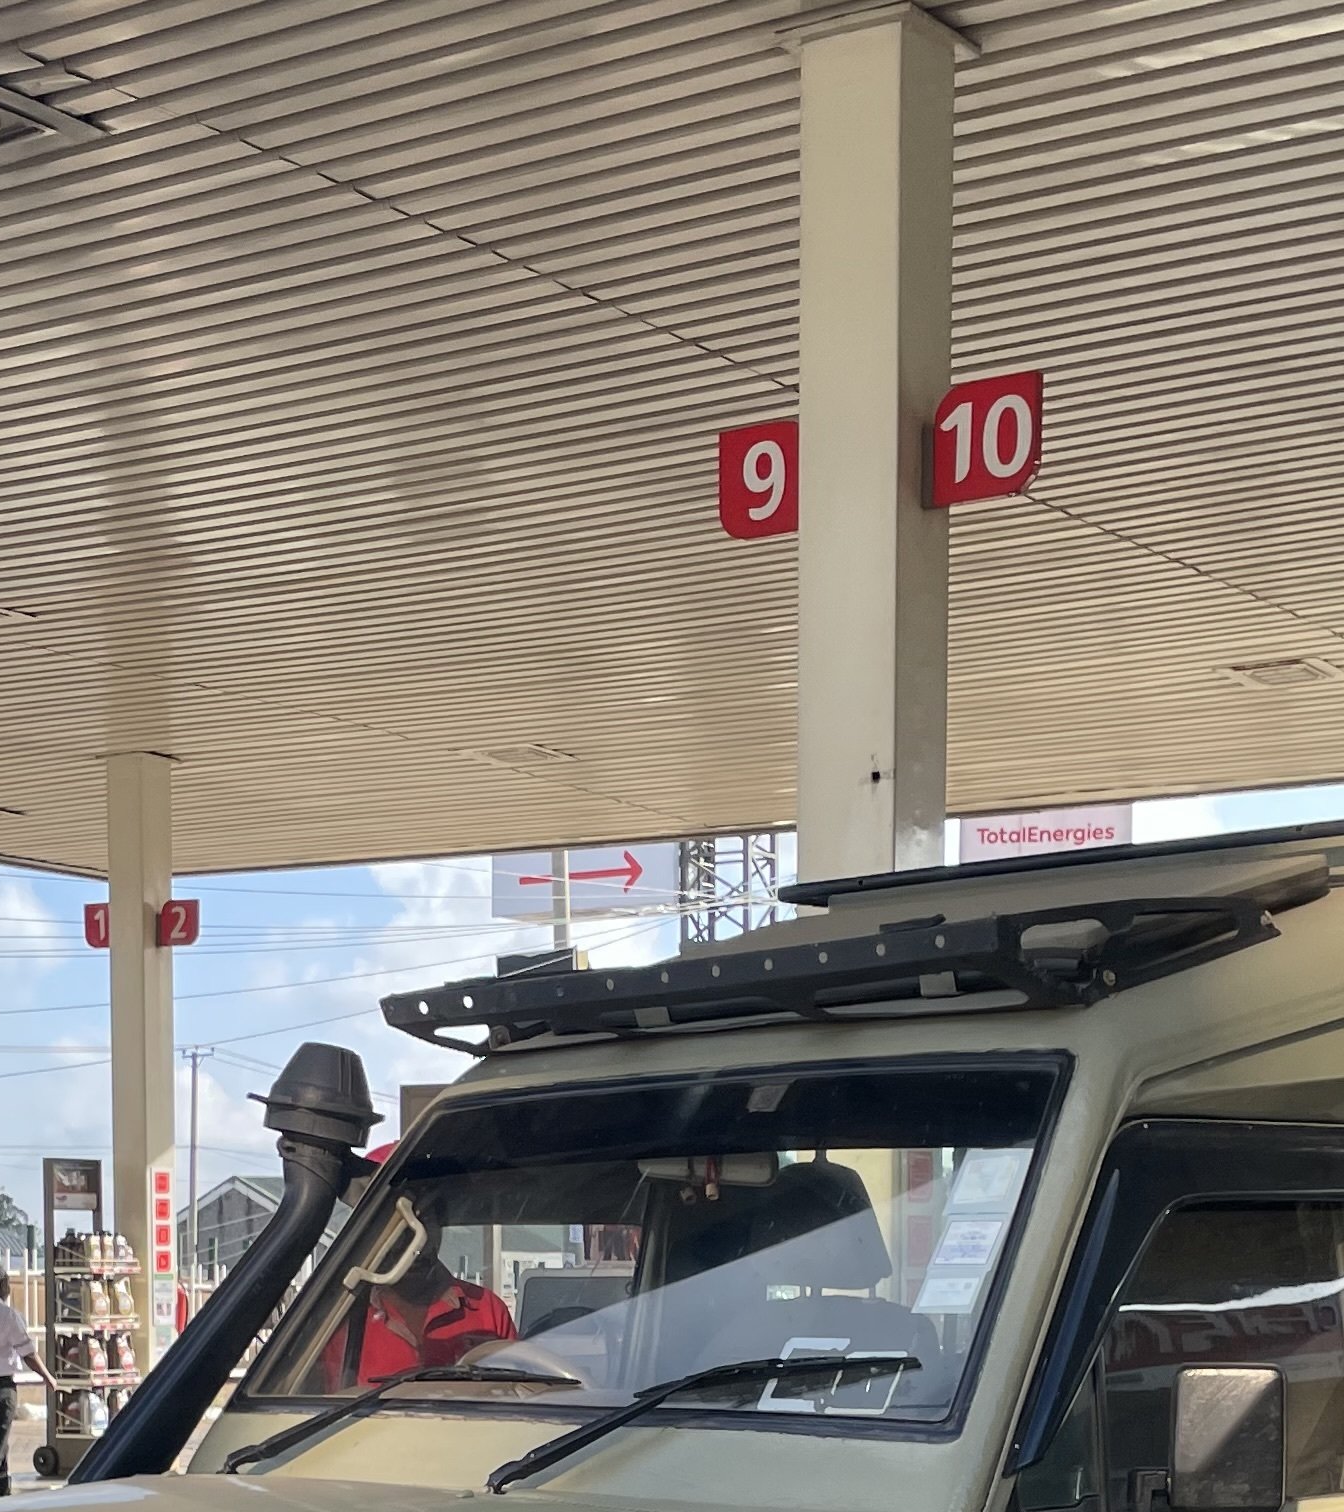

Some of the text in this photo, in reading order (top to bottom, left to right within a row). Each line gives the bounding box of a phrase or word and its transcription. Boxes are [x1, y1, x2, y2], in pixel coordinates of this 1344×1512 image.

[940, 394, 1033, 484] 10
[742, 440, 786, 521] 9
[976, 823, 1115, 845] TotalEnergies
[94, 909, 106, 941] 1
[170, 905, 188, 939] 2
